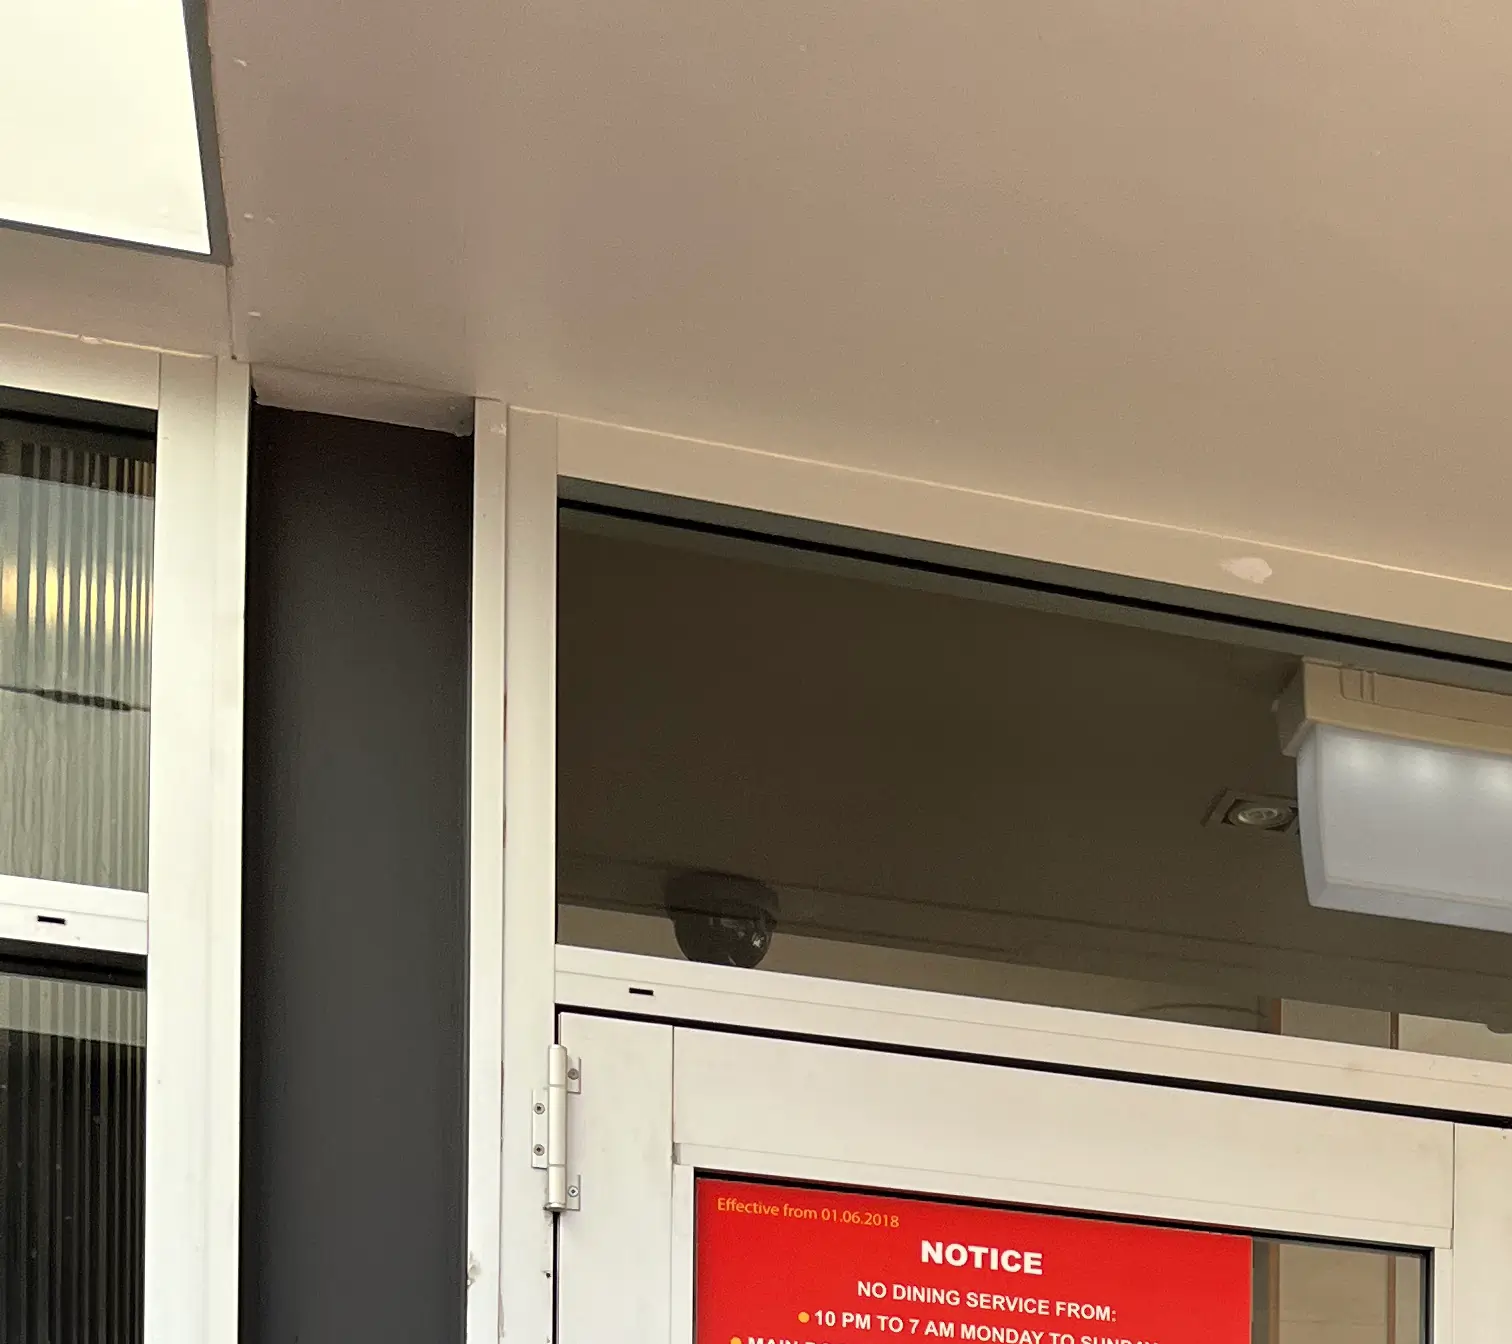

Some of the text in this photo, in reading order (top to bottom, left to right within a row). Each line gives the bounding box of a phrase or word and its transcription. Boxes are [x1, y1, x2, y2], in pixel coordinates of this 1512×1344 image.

[717, 1197, 899, 1228] Effective from 01.06.2018
[921, 1240, 1042, 1275] NOTICE
[857, 1280, 1116, 1322] NO DINING SERVICE FROM:
[814, 1310, 836, 1327] 10
[842, 1311, 871, 1330] PM
[876, 1315, 904, 1333] TO
[909, 1318, 920, 1335] 7
[924, 1320, 955, 1338] AM
